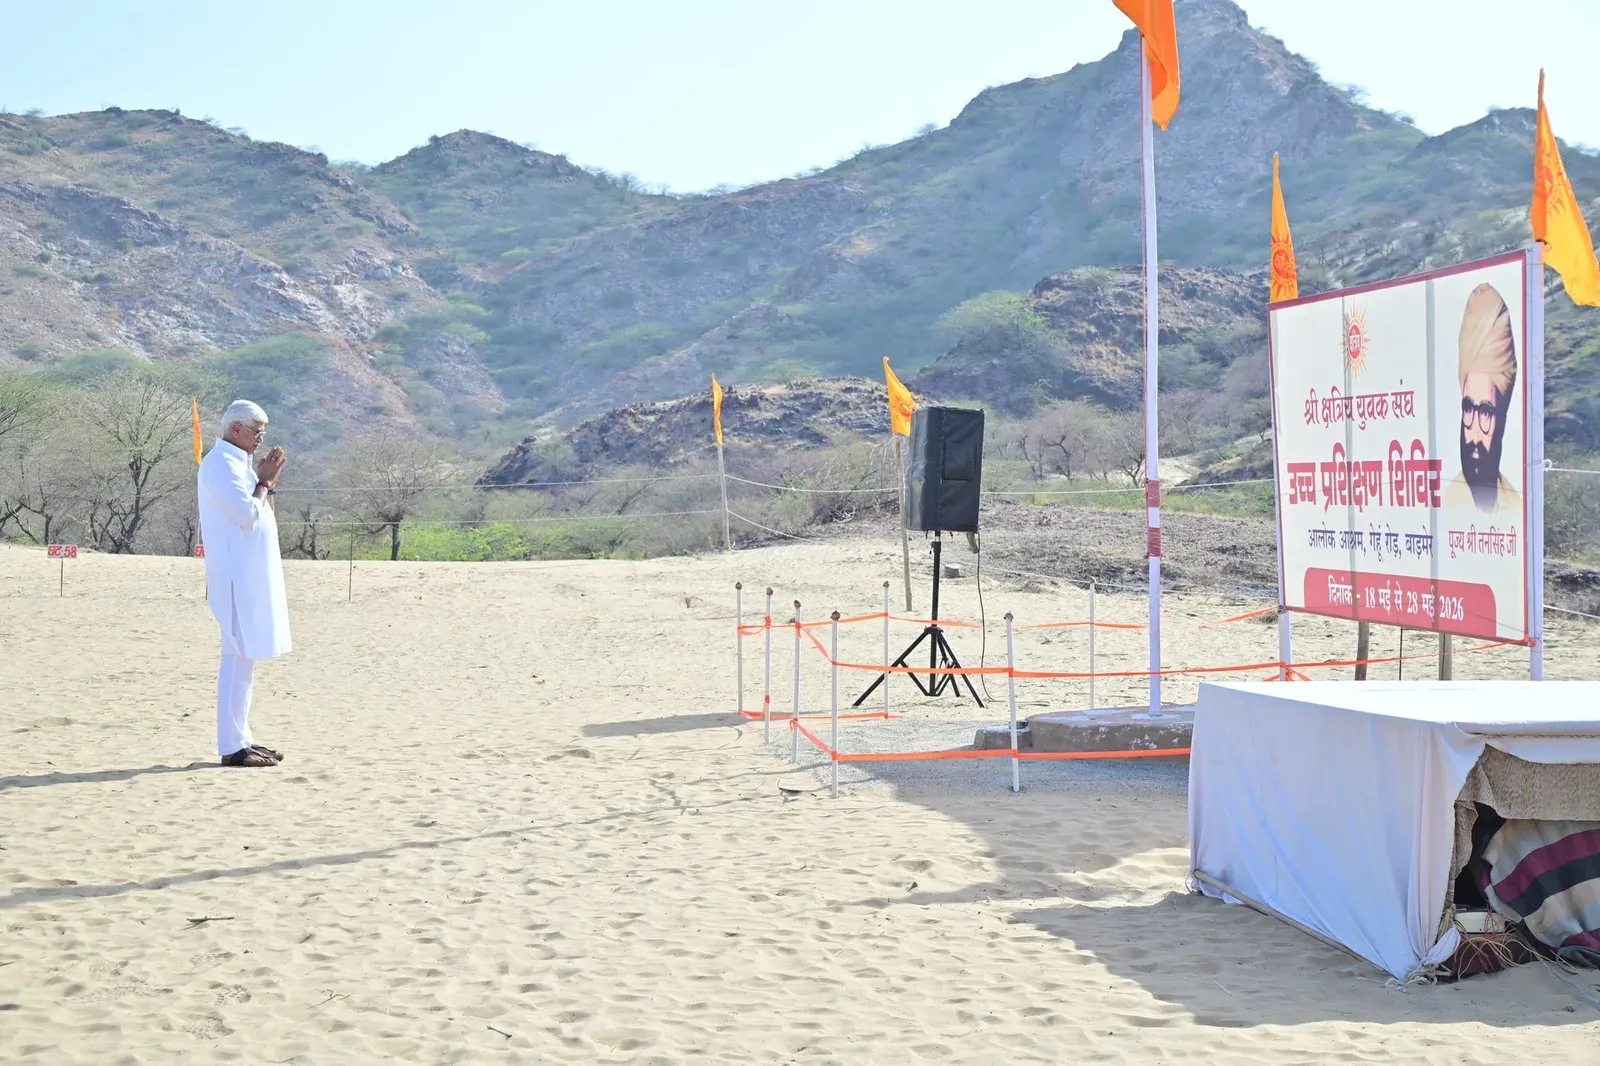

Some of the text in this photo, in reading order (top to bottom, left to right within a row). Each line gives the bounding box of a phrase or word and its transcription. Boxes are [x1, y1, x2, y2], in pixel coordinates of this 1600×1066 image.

[1304, 379, 1416, 430] श्री क्षत्रिय युवक संघ
[1287, 438, 1442, 513] उच्च प्रशिक्षण शिविर
[64, 545, 77, 558] 58
[1308, 521, 1336, 549] आलोक
[1339, 530, 1367, 557] आश्रम,
[1448, 524, 1517, 558] पूज्य श्री तनसिंह जी
[1328, 574, 1353, 606] दिनांक
[1364, 586, 1376, 609] 18
[1378, 580, 1391, 616] मई
[1394, 581, 1403, 612] से
[1406, 591, 1419, 614] 28
[1421, 584, 1435, 622] मई
[1439, 595, 1465, 621] 2026
